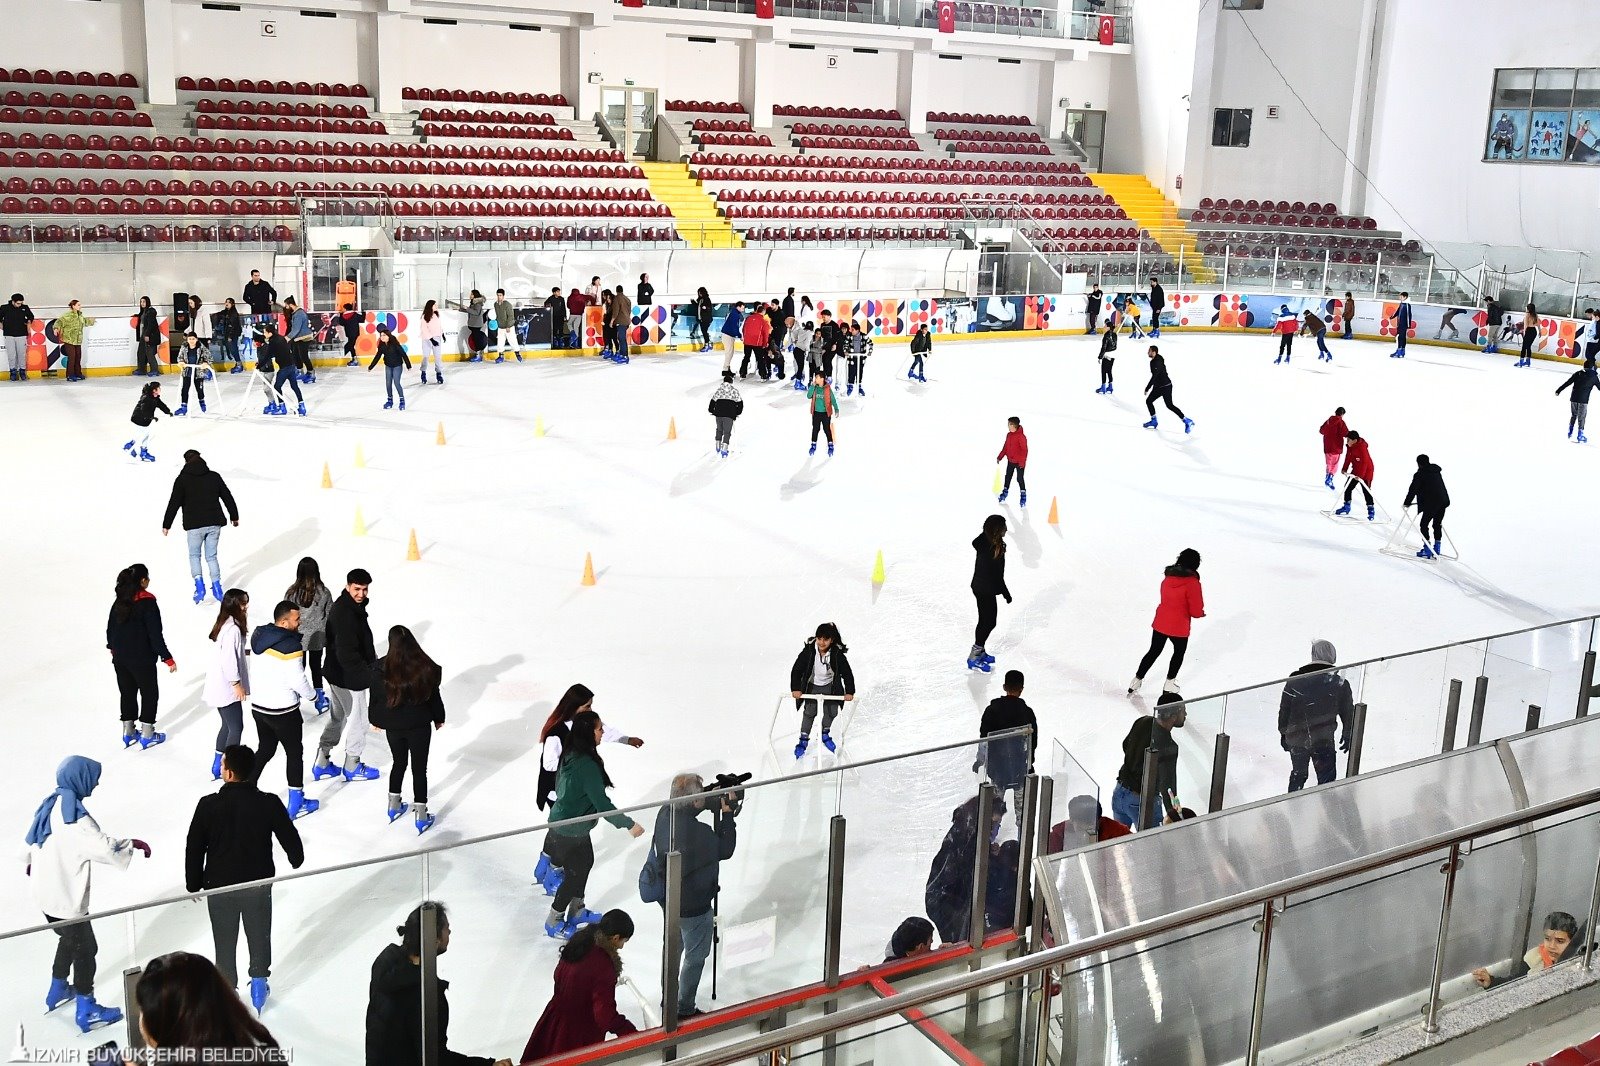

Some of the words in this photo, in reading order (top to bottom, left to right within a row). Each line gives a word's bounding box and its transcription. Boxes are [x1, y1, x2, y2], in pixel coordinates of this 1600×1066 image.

[264, 24, 273, 34] C
[829, 57, 836, 66] D
[1269, 107, 1276, 116] E
